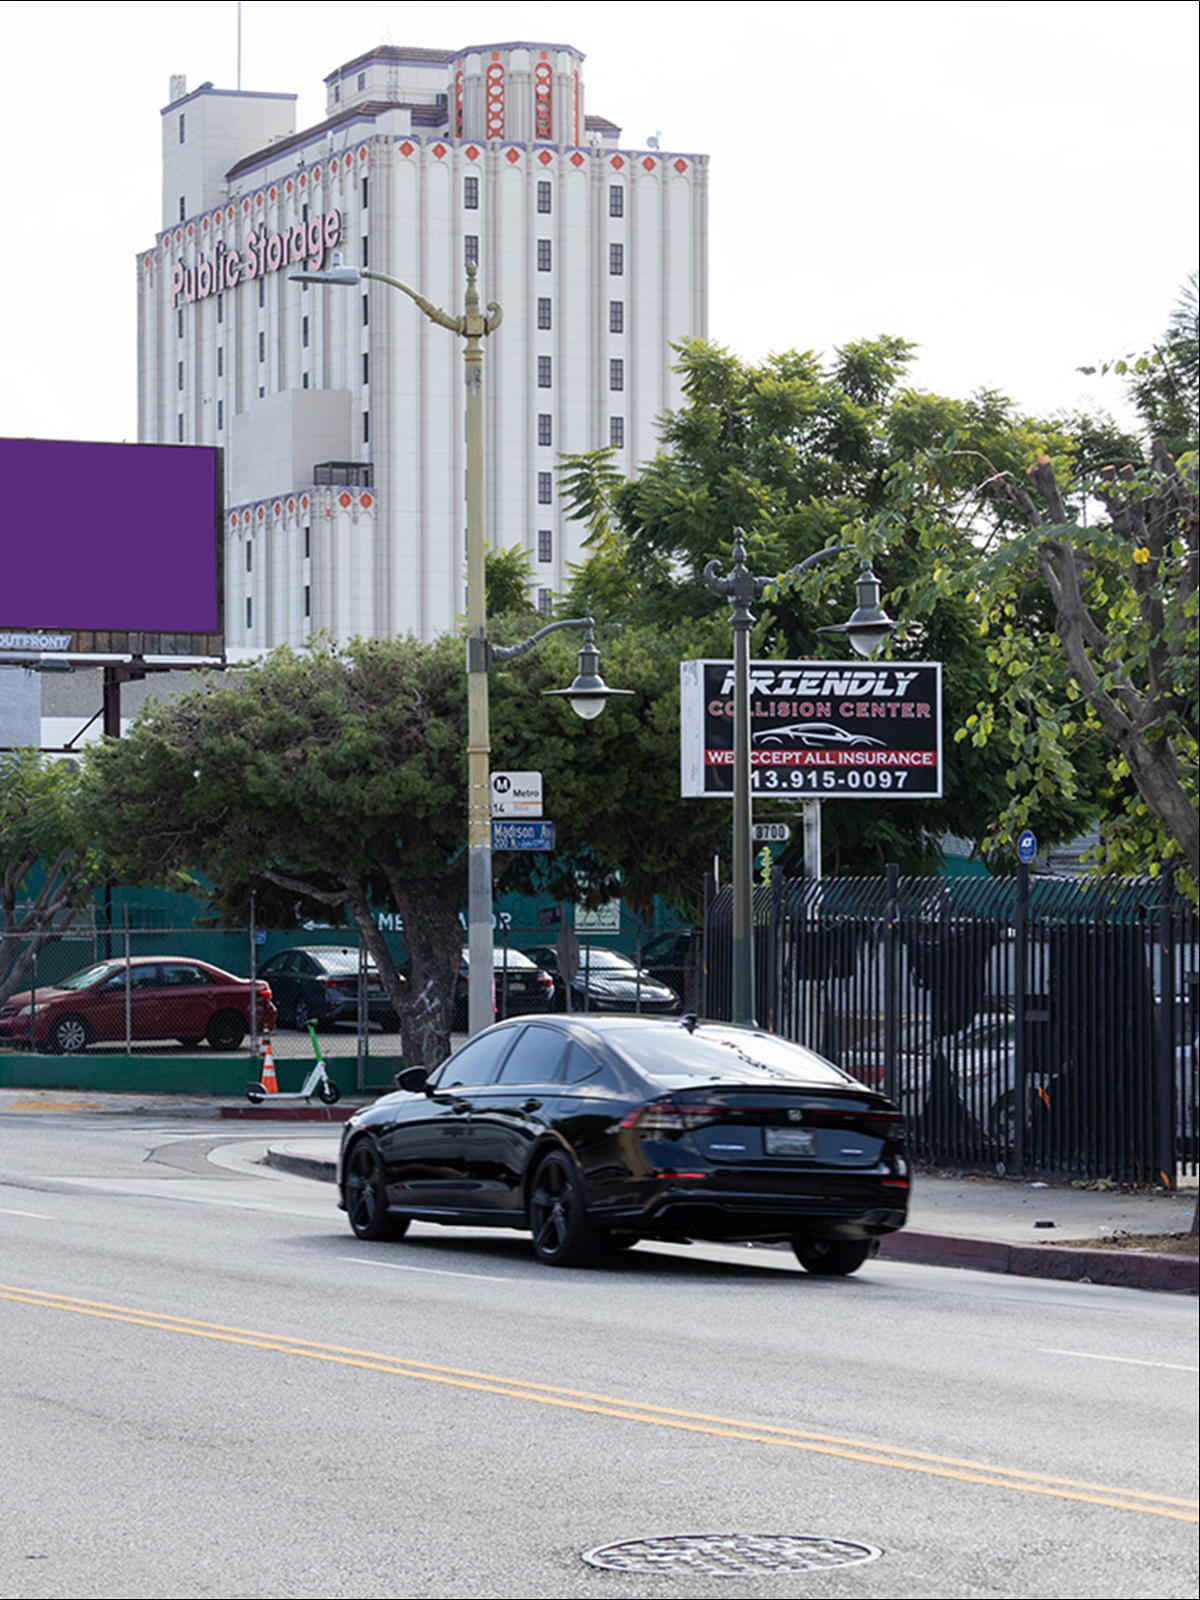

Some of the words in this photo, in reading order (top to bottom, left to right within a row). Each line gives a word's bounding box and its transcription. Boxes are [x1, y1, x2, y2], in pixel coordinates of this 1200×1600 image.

[171, 242, 240, 309] Public
[245, 208, 342, 280] Storage
[839, 702, 931, 718] CENTER
[708, 752, 735, 763] WE
[750, 752, 802, 764] CCEPT
[804, 752, 835, 765] ALL
[839, 752, 932, 765] INSURANCE
[750, 770, 908, 788] 13.915-0097
[513, 789, 539, 797] Metro
[493, 803, 505, 813] 14
[494, 823, 535, 838] Madison
